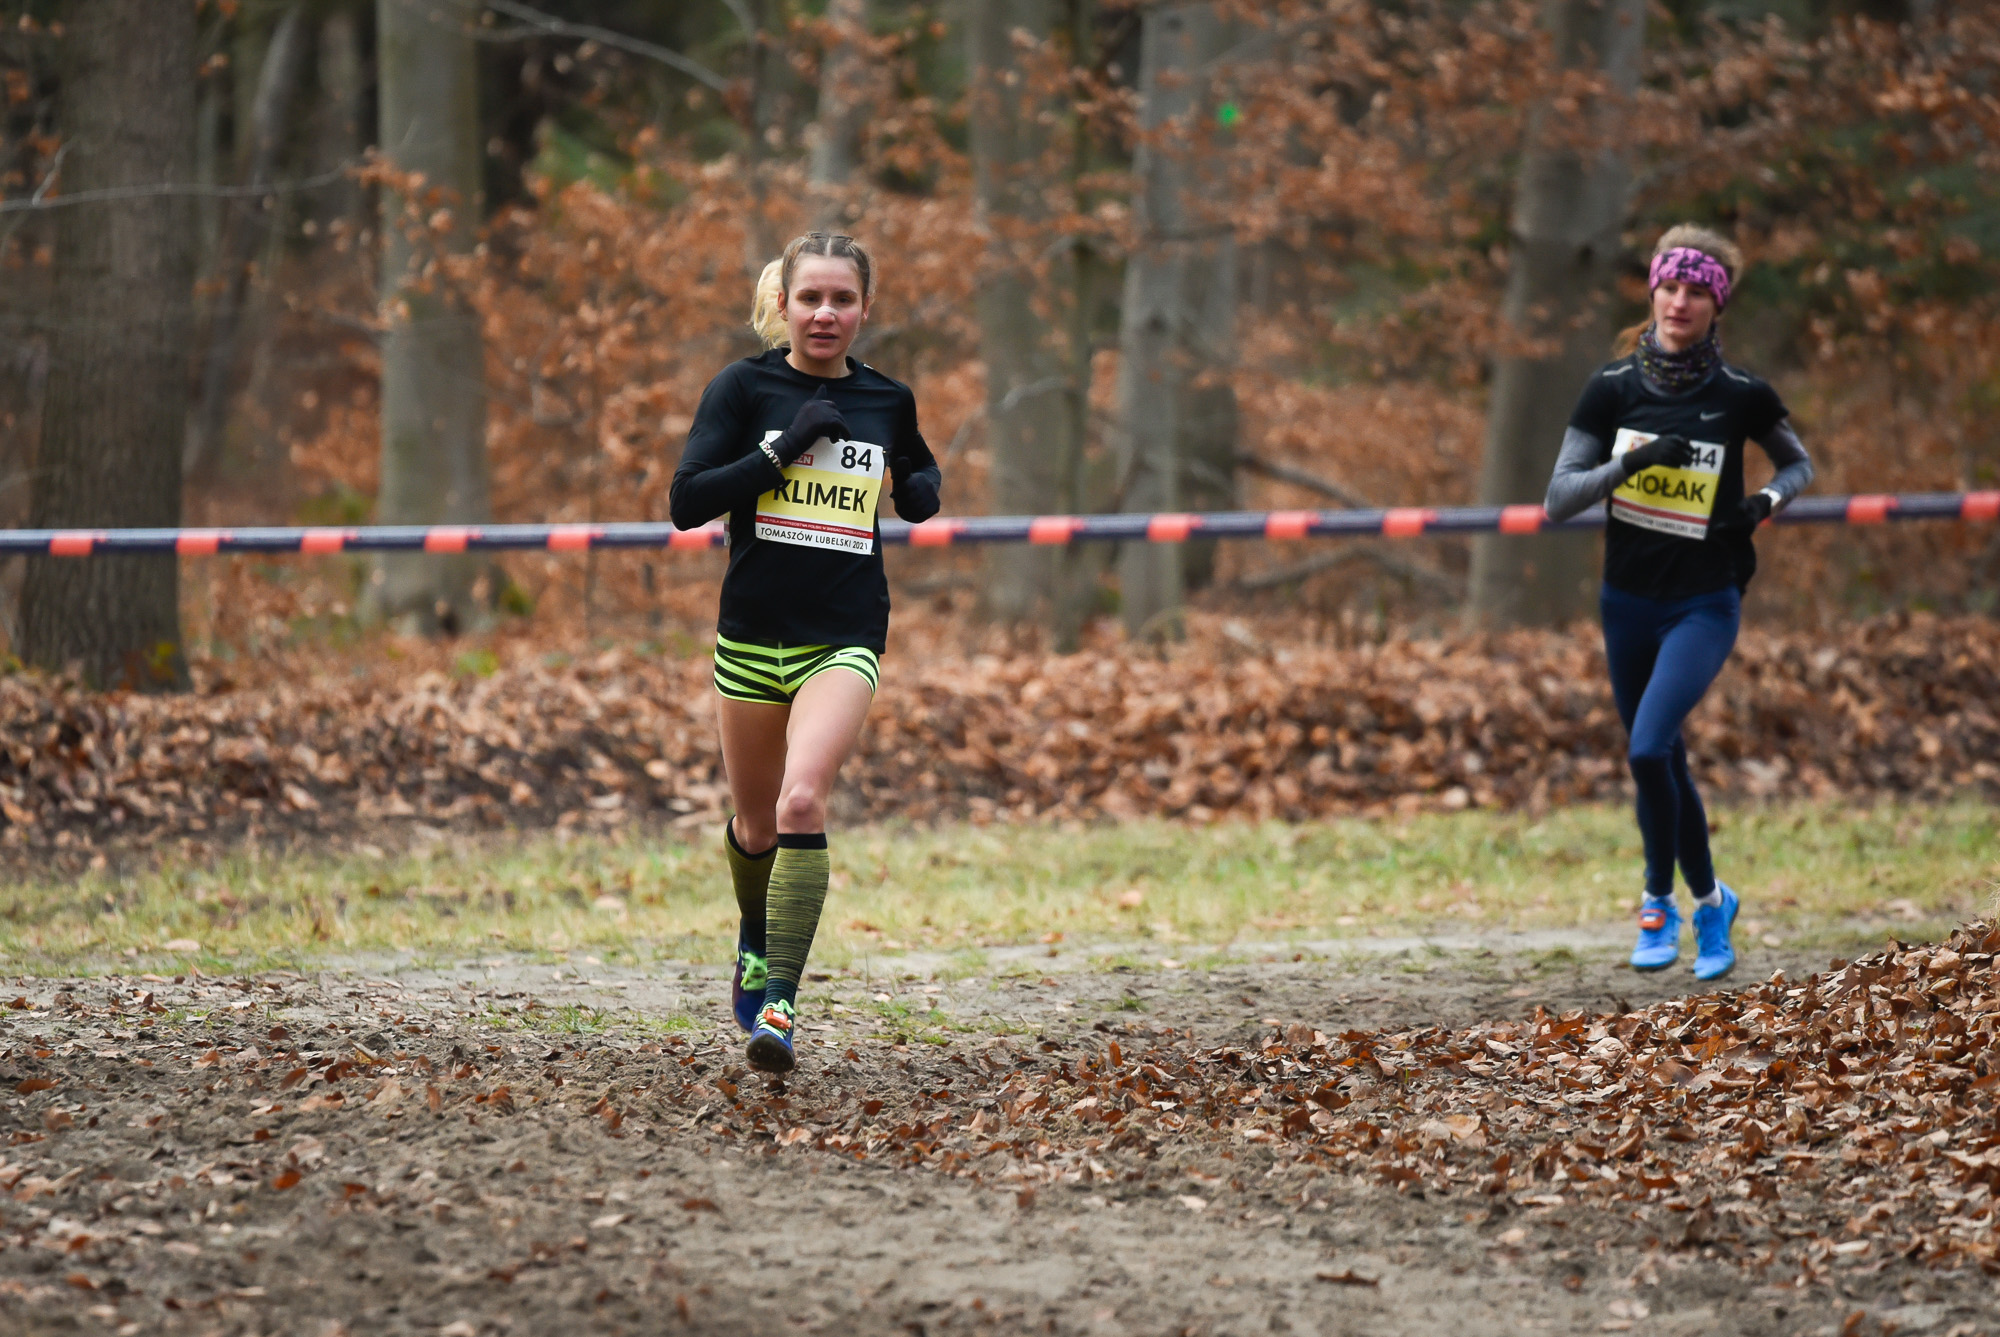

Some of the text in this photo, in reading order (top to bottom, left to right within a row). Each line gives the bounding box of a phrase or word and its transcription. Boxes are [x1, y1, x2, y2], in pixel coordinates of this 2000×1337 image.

[841, 446, 872, 472] 84
[774, 479, 868, 514] KLIMEK
[761, 527, 868, 551] TOMASZÓW LUBELSKI 2021
